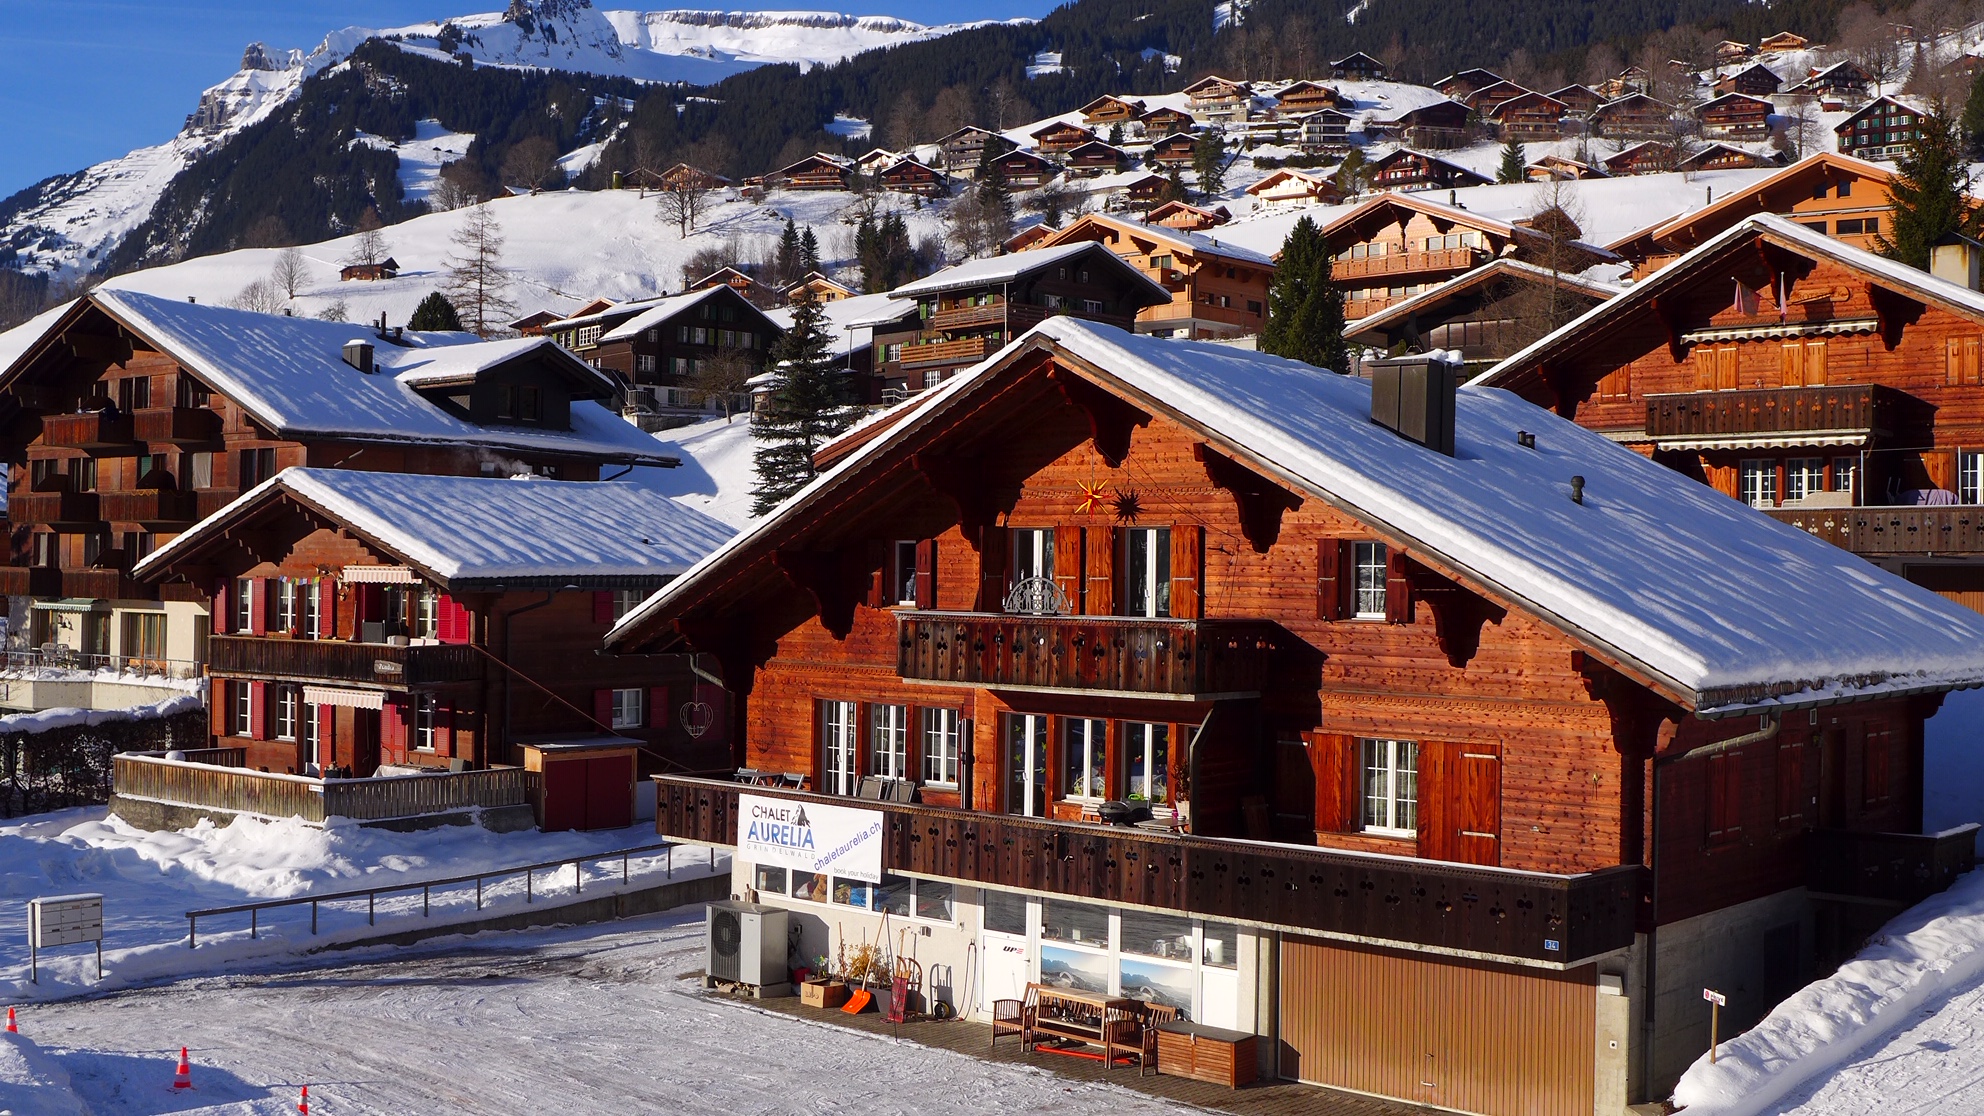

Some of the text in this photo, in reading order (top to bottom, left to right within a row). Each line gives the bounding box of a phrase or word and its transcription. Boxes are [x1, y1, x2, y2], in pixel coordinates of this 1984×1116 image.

[751, 805, 791, 822] CHALET
[747, 821, 815, 849] AURELIA
[746, 843, 816, 860] GRINDELWALD
[814, 822, 882, 871] chaletaurelia.ch
[833, 867, 847, 875] book
[860, 871, 879, 881] holiday
